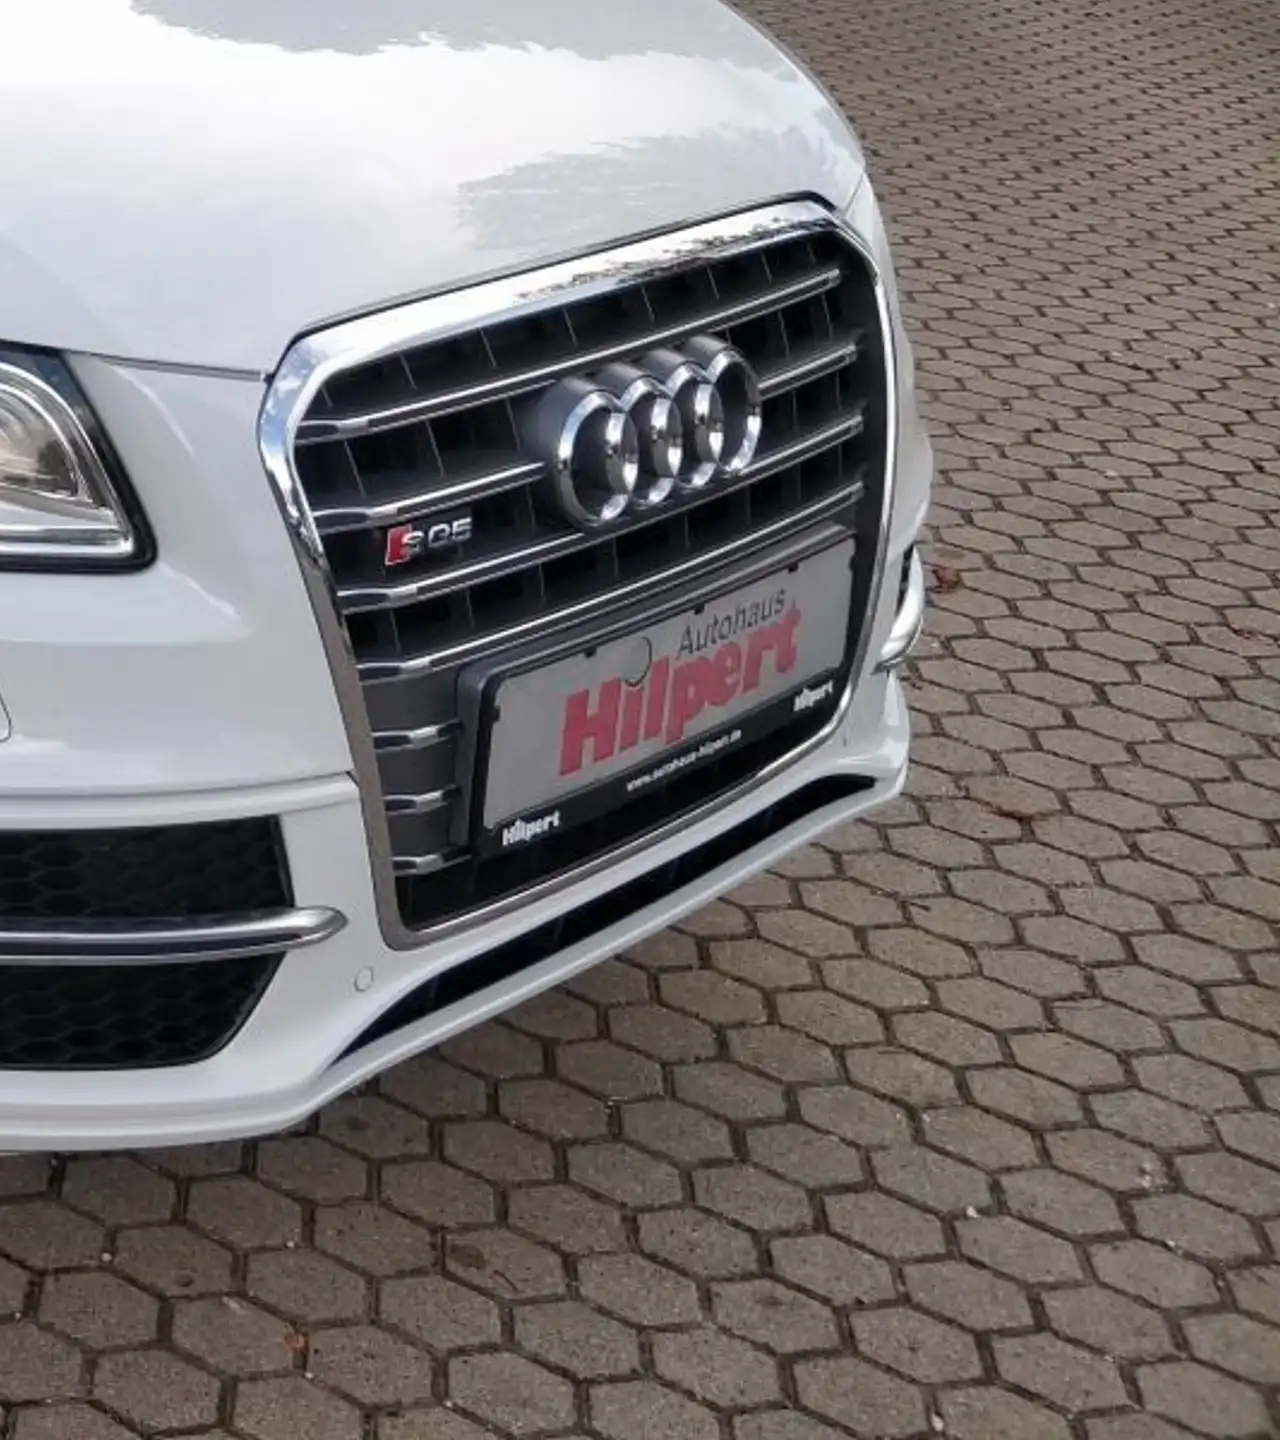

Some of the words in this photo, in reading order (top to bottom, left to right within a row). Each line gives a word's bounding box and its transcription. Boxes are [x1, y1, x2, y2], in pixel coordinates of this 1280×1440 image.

[676, 588, 787, 659] Autohaus
[558, 600, 802, 777] Hilpert
[502, 809, 561, 846] Hilpert
